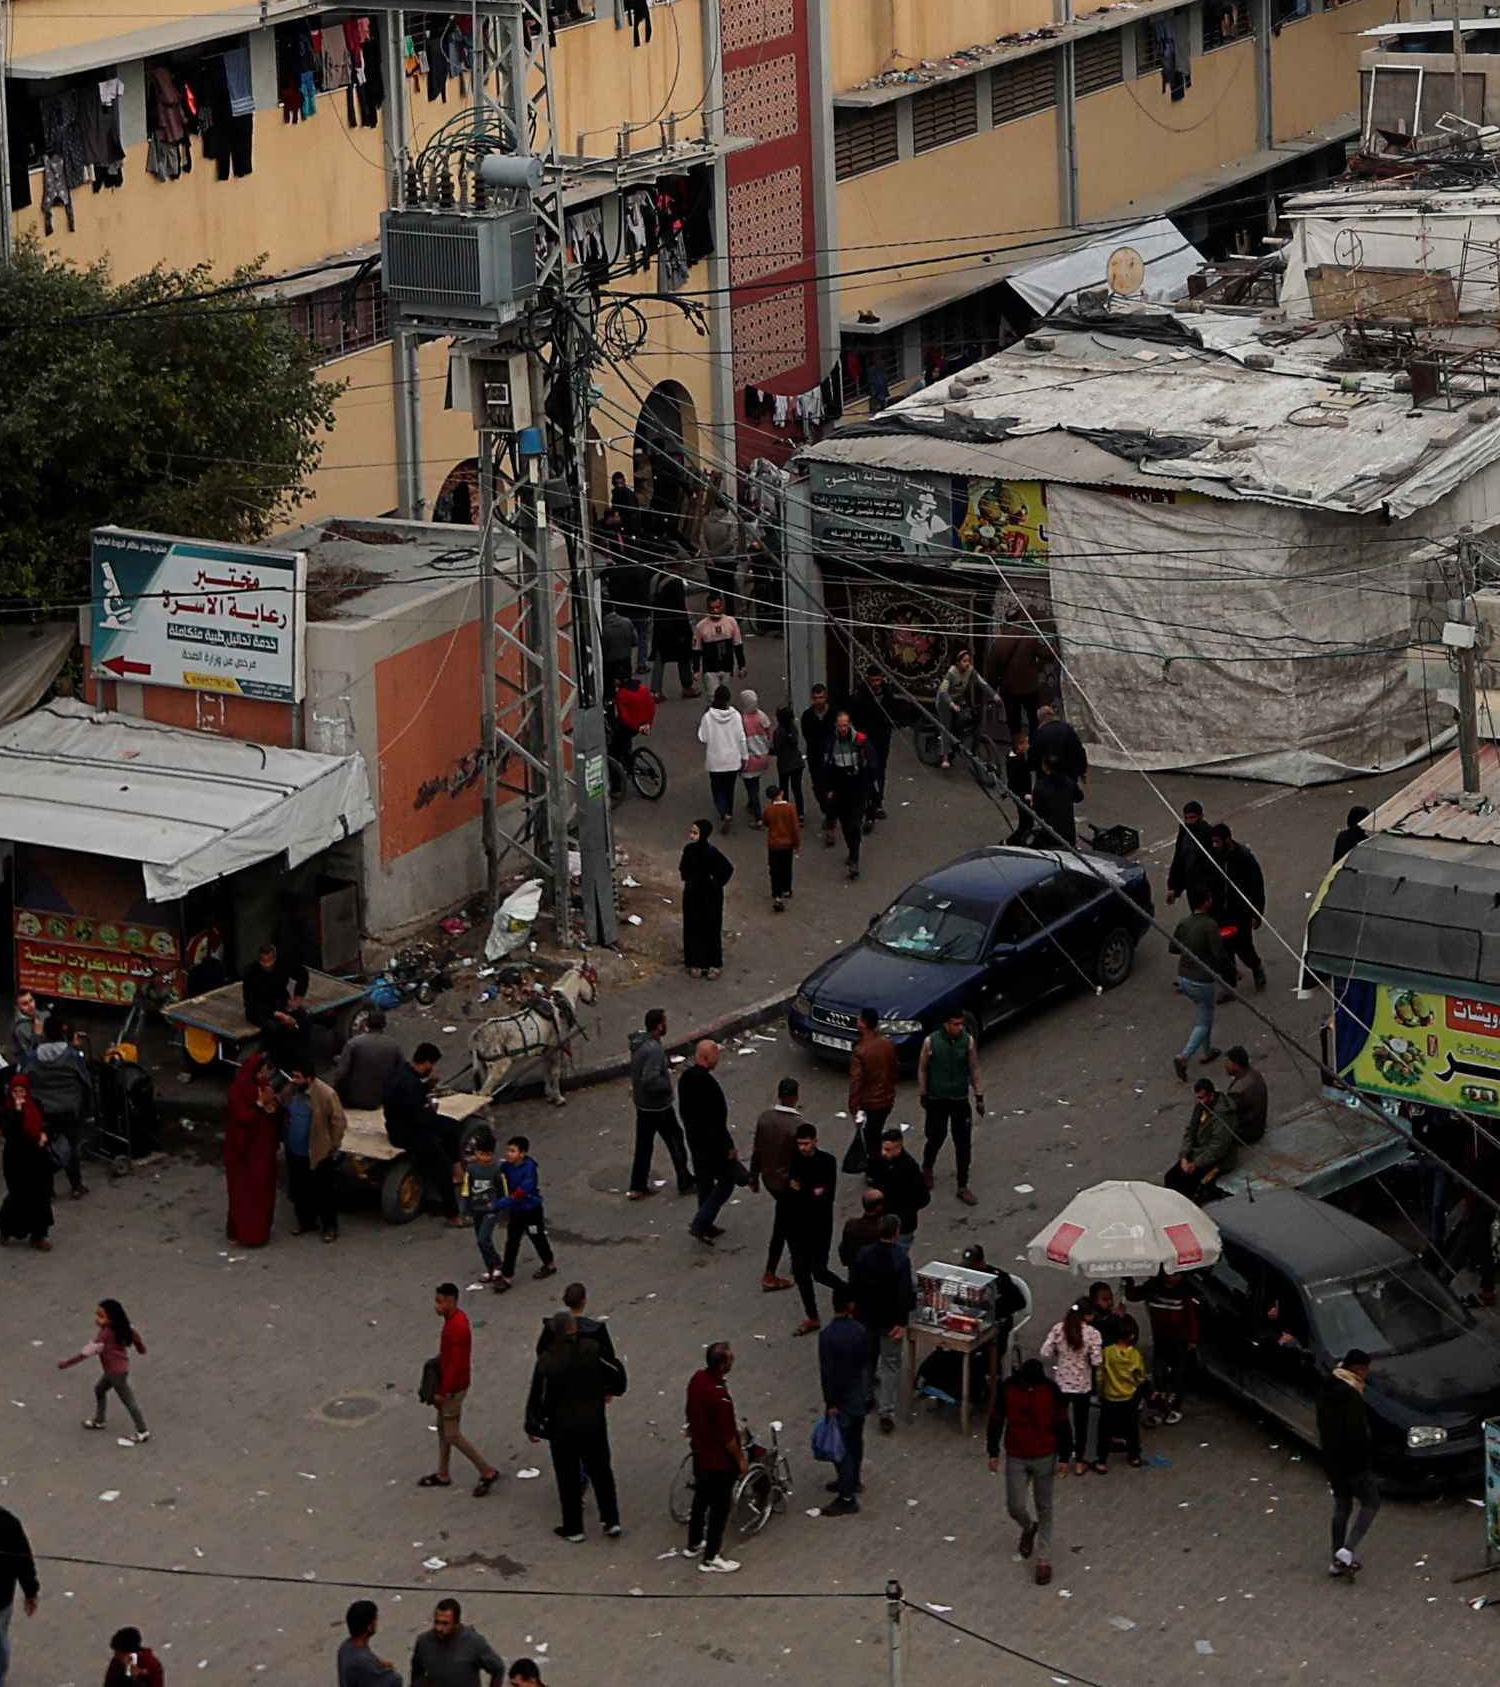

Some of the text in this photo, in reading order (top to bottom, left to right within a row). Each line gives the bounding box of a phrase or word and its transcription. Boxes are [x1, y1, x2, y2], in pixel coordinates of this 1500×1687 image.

[192, 567, 260, 591] مختبر
[228, 597, 288, 629] رعاية
[254, 636, 277, 650] خدمة
